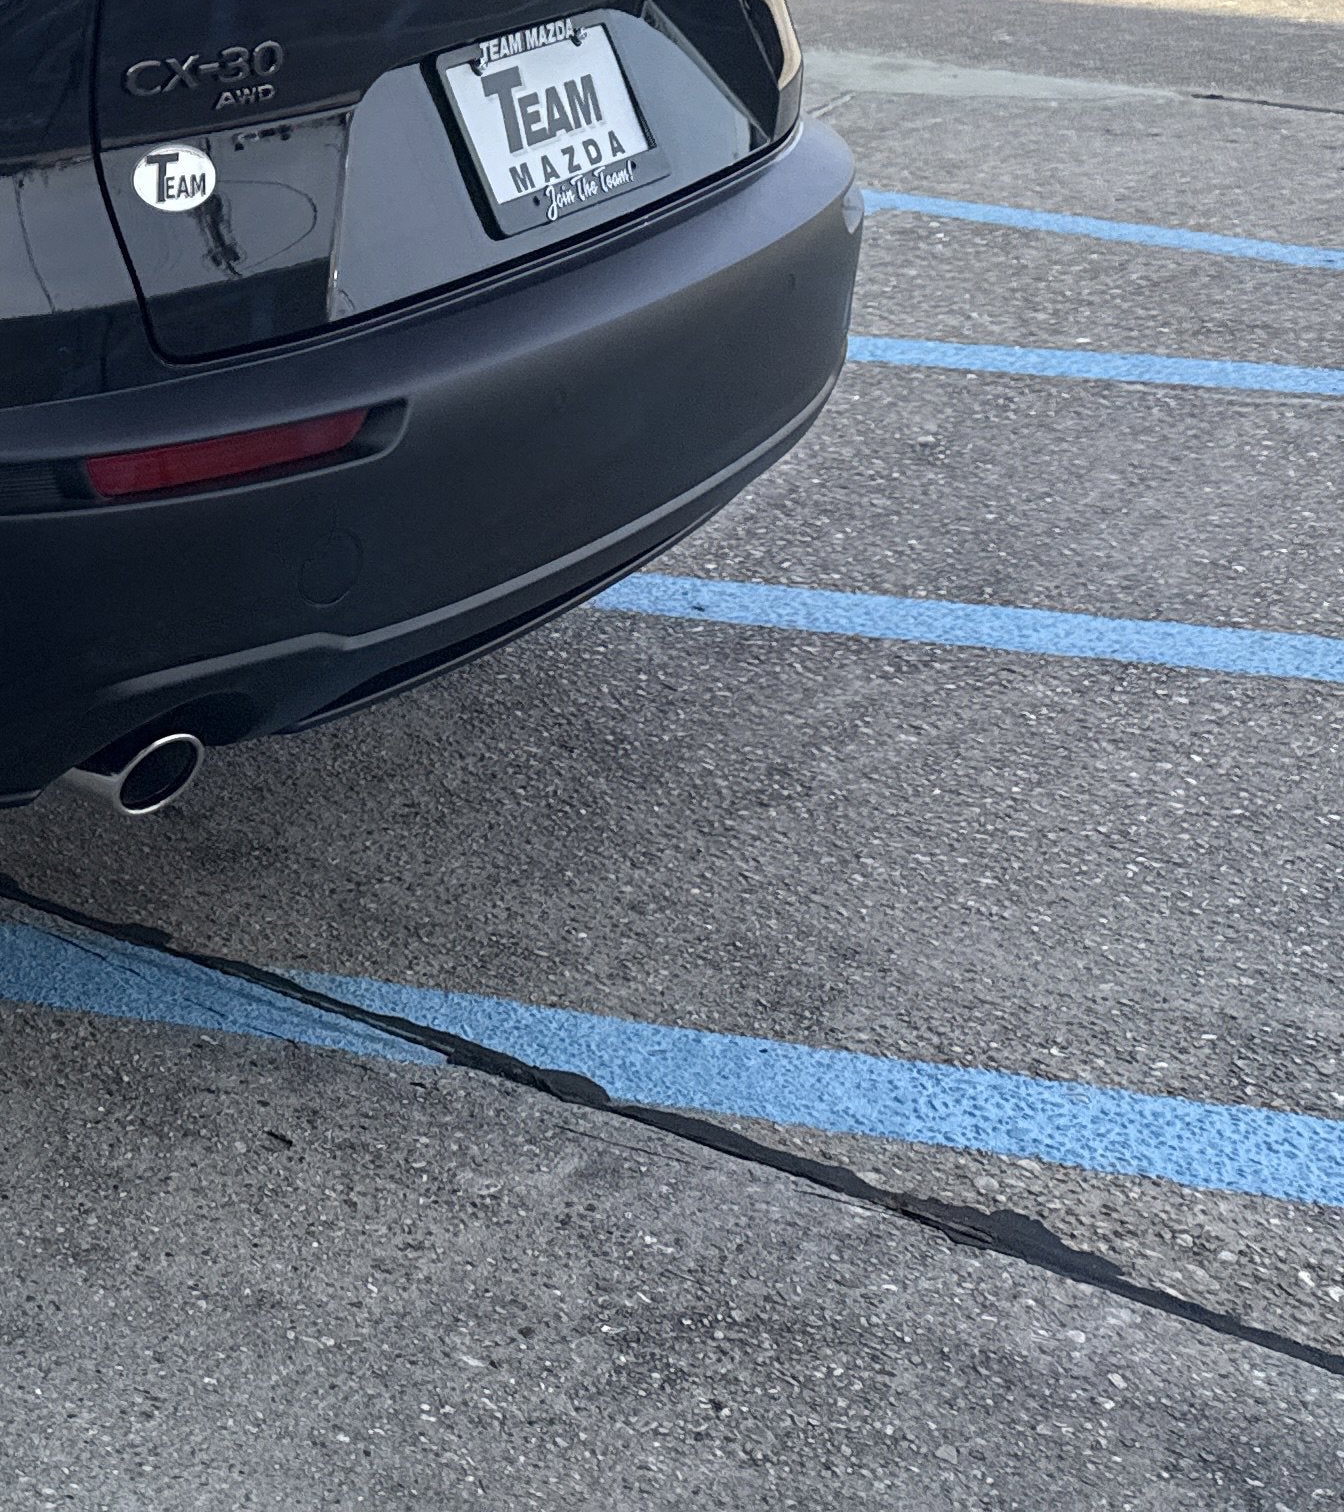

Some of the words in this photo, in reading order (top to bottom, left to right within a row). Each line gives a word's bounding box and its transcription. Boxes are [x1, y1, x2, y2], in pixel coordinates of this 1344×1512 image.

[126, 40, 283, 96] CX-30
[479, 31, 522, 64] TEAM
[525, 19, 576, 51] MAZDA
[215, 83, 276, 110] AWD
[480, 65, 603, 154] TEAM
[146, 152, 207, 203] TEAM
[509, 130, 626, 194] MAZDA
[546, 182, 576, 221] Join
[570, 174, 598, 202] The
[592, 159, 634, 193] Team!
